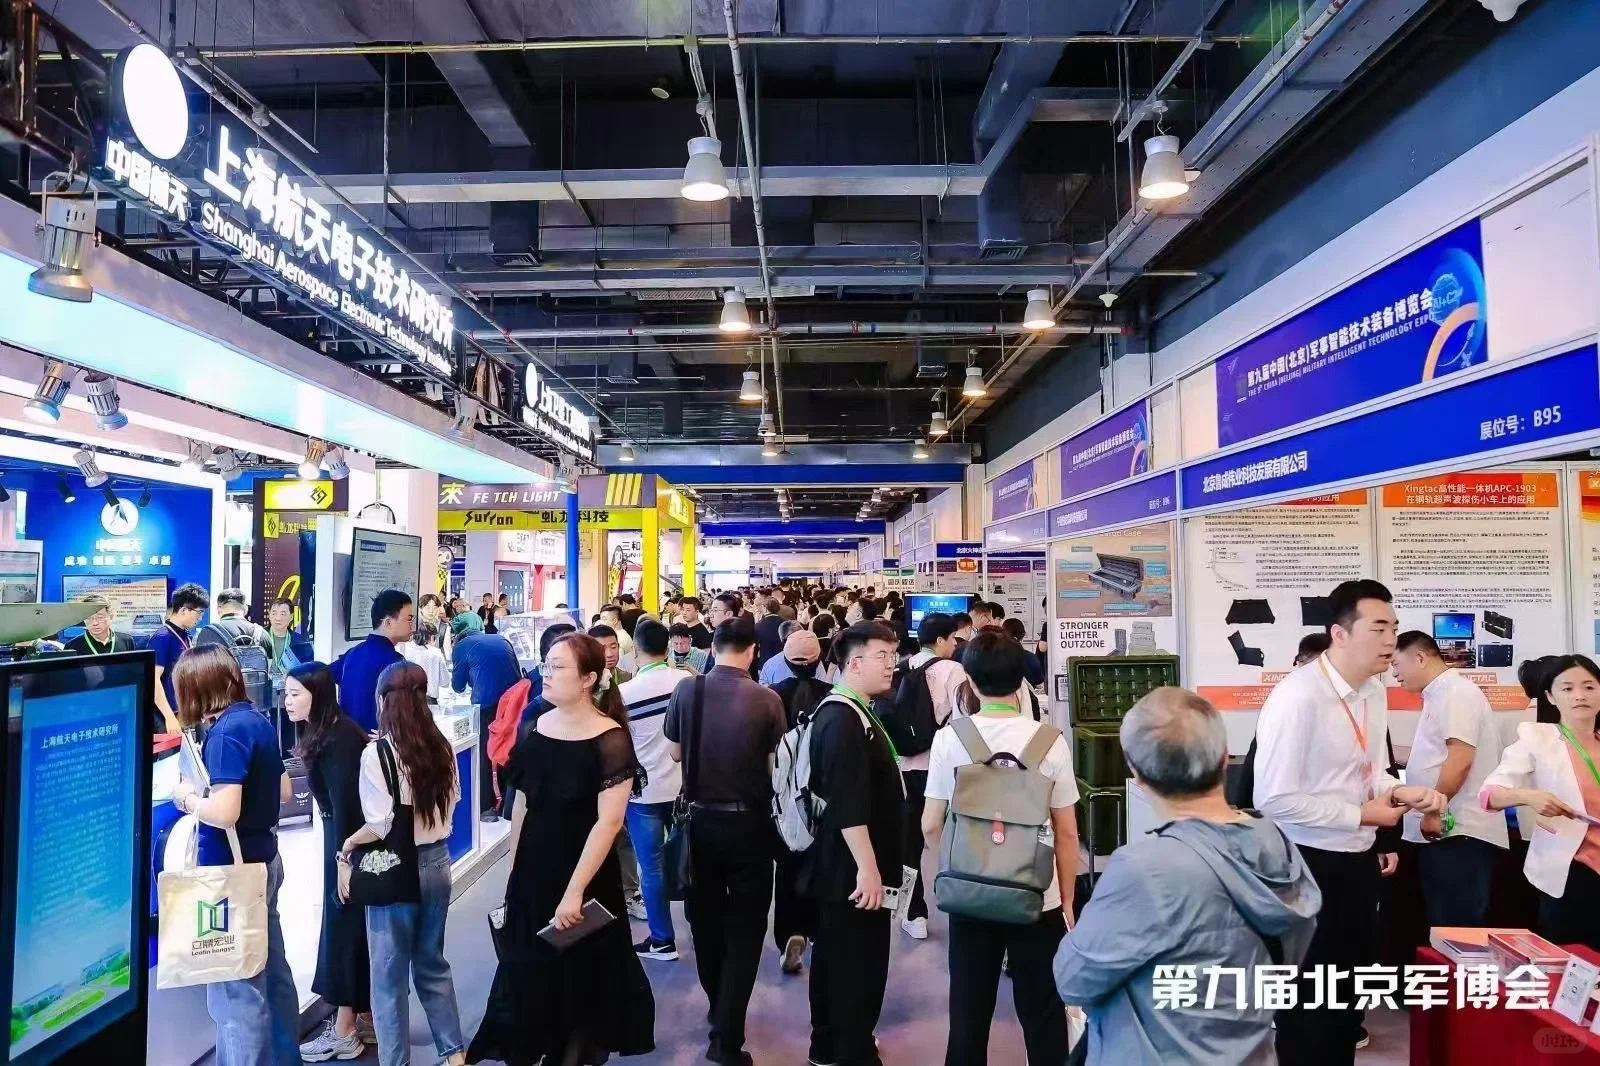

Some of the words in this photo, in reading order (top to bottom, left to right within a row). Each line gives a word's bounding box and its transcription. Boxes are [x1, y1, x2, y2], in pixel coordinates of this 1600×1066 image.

[105, 136, 189, 223] 中国航天
[203, 124, 454, 350] 上海航天电子技术研究所
[202, 201, 275, 266] Shanghai
[274, 250, 339, 307] Aerospace
[341, 291, 386, 334] Electronic
[1264, 379, 1278, 391] CHINA
[1303, 360, 1327, 375] MILITARY
[1328, 341, 1366, 364] INTELLIGENT
[1368, 322, 1413, 347] TECHNOLOGY
[1533, 405, 1561, 427] B95
[522, 491, 562, 503] LIGHT
[1406, 494, 1536, 504] 在钢轨超声波探伤小车上的应用
[1060, 621, 1109, 630] STRONGER
[1060, 631, 1098, 639] LIGHTER
[1060, 640, 1105, 649] OUTZONE
[40, 723, 119, 749] 上海航天电子技术研究所
